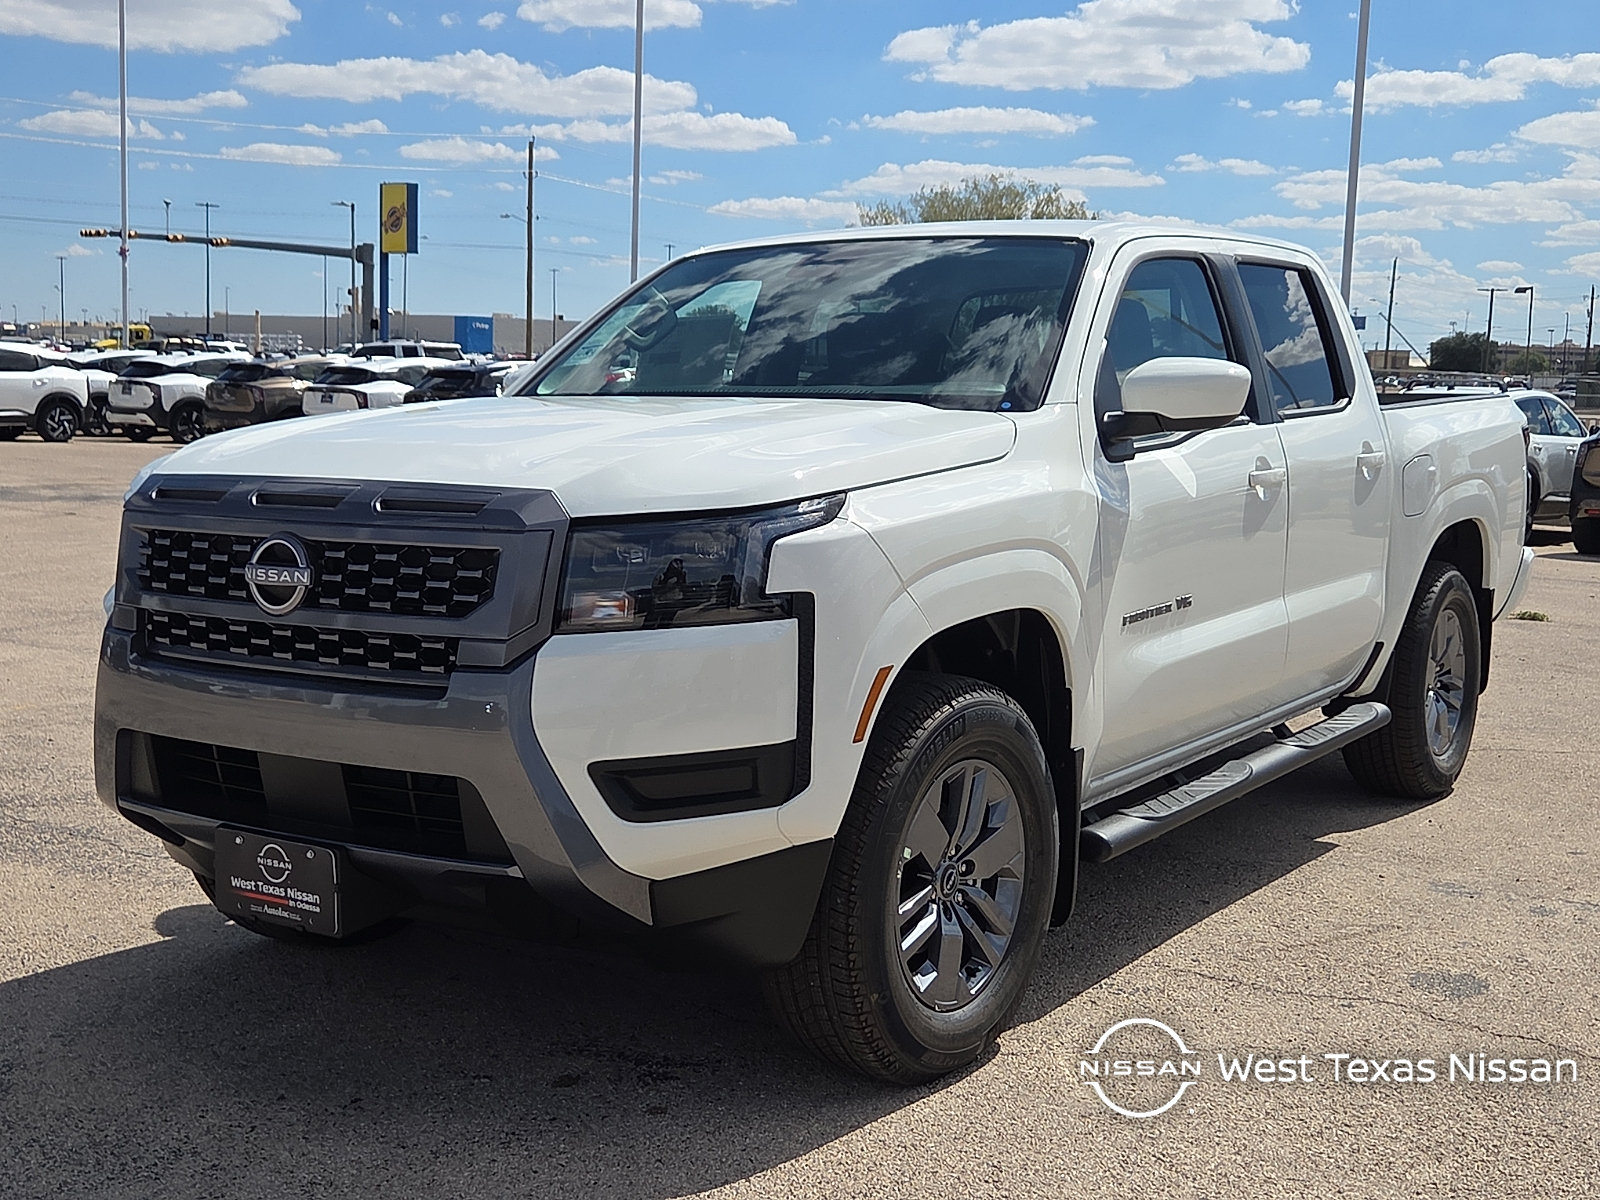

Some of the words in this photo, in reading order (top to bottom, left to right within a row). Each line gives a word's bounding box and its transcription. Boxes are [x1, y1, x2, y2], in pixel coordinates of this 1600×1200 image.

[245, 567, 308, 583] NISSAN
[1175, 593, 1193, 610] V6
[905, 717, 965, 797] MICHELIN
[257, 856, 292, 870] NISSAN
[230, 875, 256, 891] West
[257, 881, 285, 897] Texas
[287, 887, 320, 904] Nissan
[296, 901, 321, 913] Odessa
